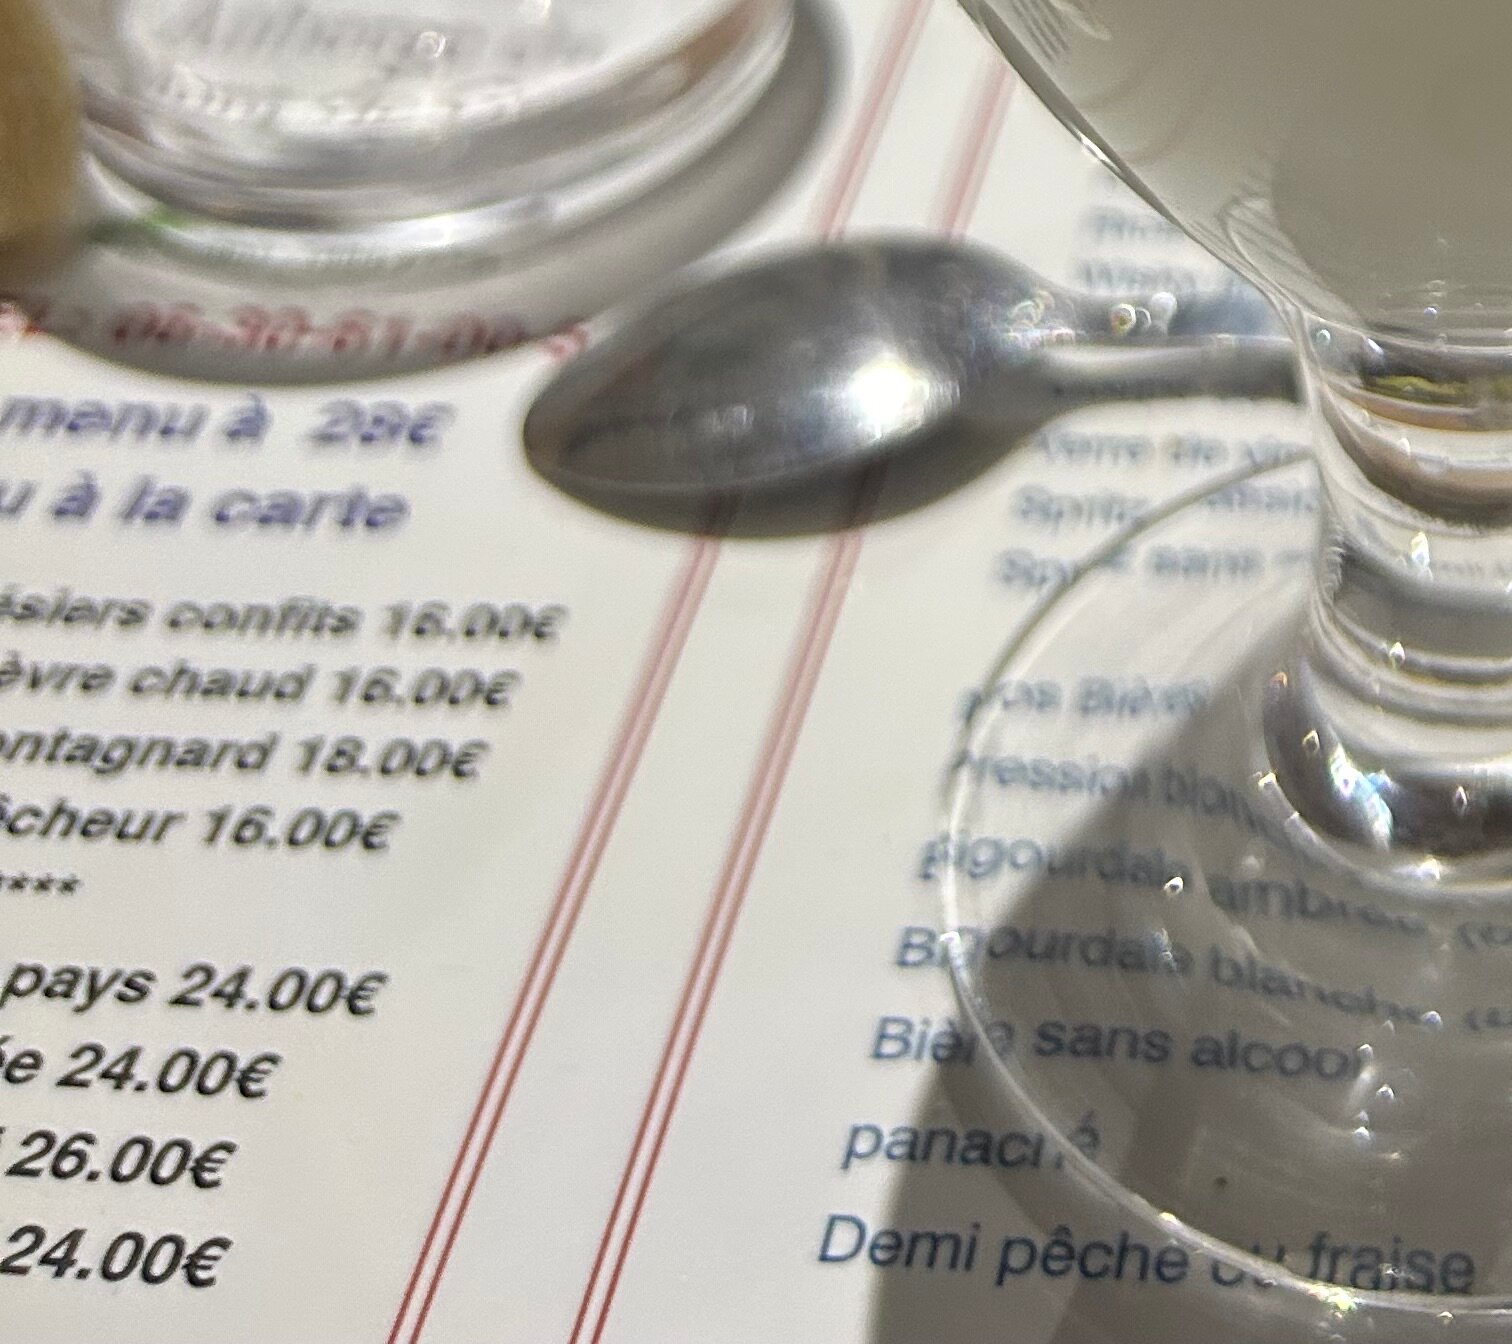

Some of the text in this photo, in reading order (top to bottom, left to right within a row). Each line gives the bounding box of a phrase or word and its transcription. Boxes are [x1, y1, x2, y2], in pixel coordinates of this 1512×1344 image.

[0, 398, 210, 440] menu
[226, 392, 273, 444] à
[52, 469, 100, 524] à
[120, 474, 193, 526] la
[210, 482, 411, 531] carte
[162, 592, 364, 639] confits
[130, 658, 318, 702] chaud
[330, 665, 521, 708] 16.00€
[0, 727, 280, 777] ntagnard
[201, 801, 404, 853] 16.00€
[0, 962, 390, 1016] pays 24.00€
[1034, 1018, 1172, 1064] sans
[56, 1042, 284, 1099] 24.00€
[4, 1129, 240, 1189] 26.00€
[0, 1224, 234, 1289] 24.00€
[816, 1213, 983, 1274] Demi
[994, 1224, 1190, 1288] pêche
[1307, 1230, 1476, 1296] fraise
